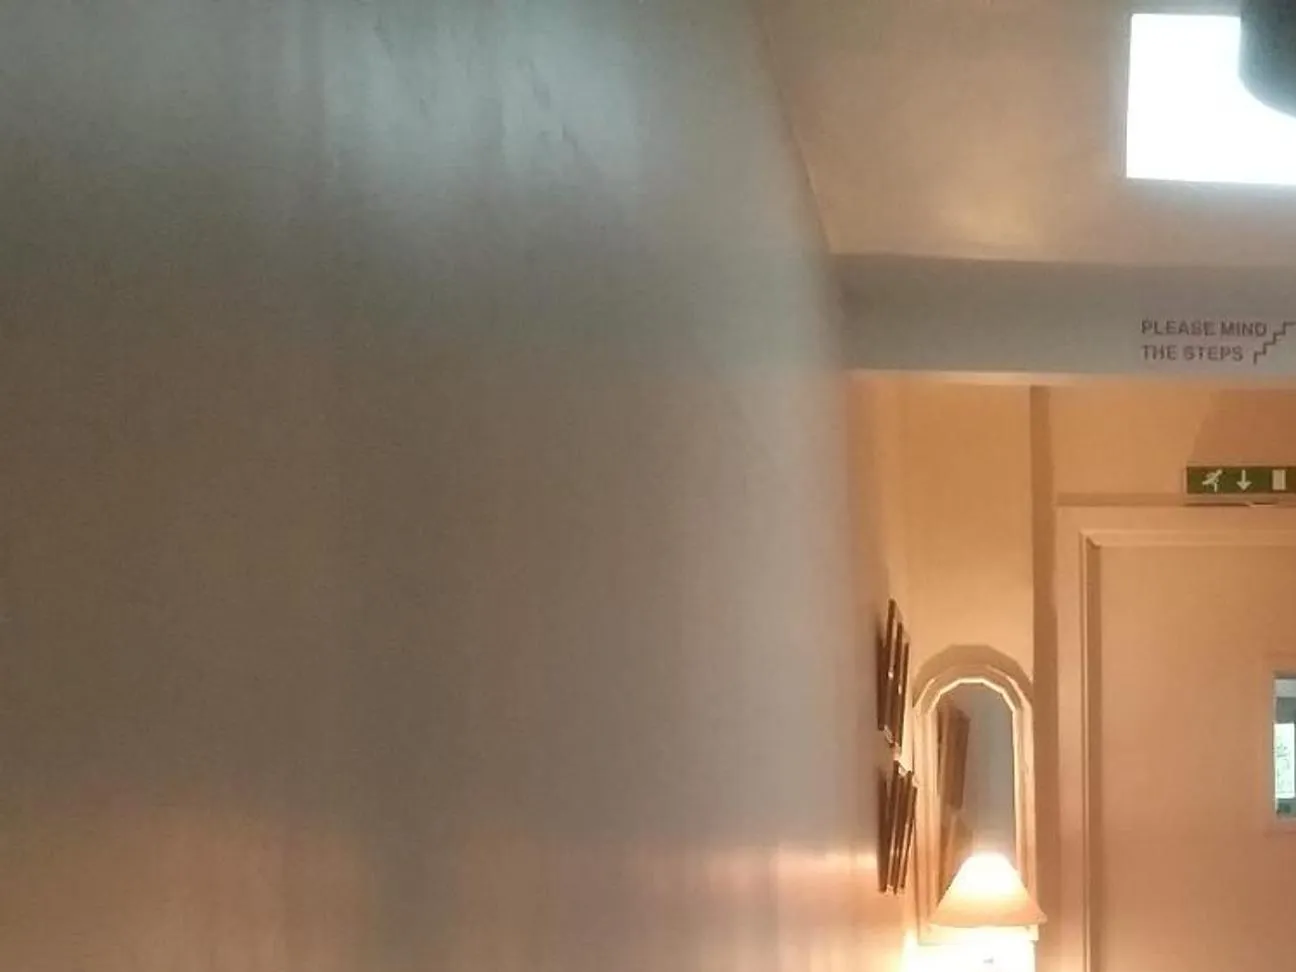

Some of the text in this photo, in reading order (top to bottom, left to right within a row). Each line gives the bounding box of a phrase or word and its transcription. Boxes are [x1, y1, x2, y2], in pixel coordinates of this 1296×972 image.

[1141, 320, 1267, 337] PLEASE MIND
[1142, 345, 1243, 361] THE STEPS
